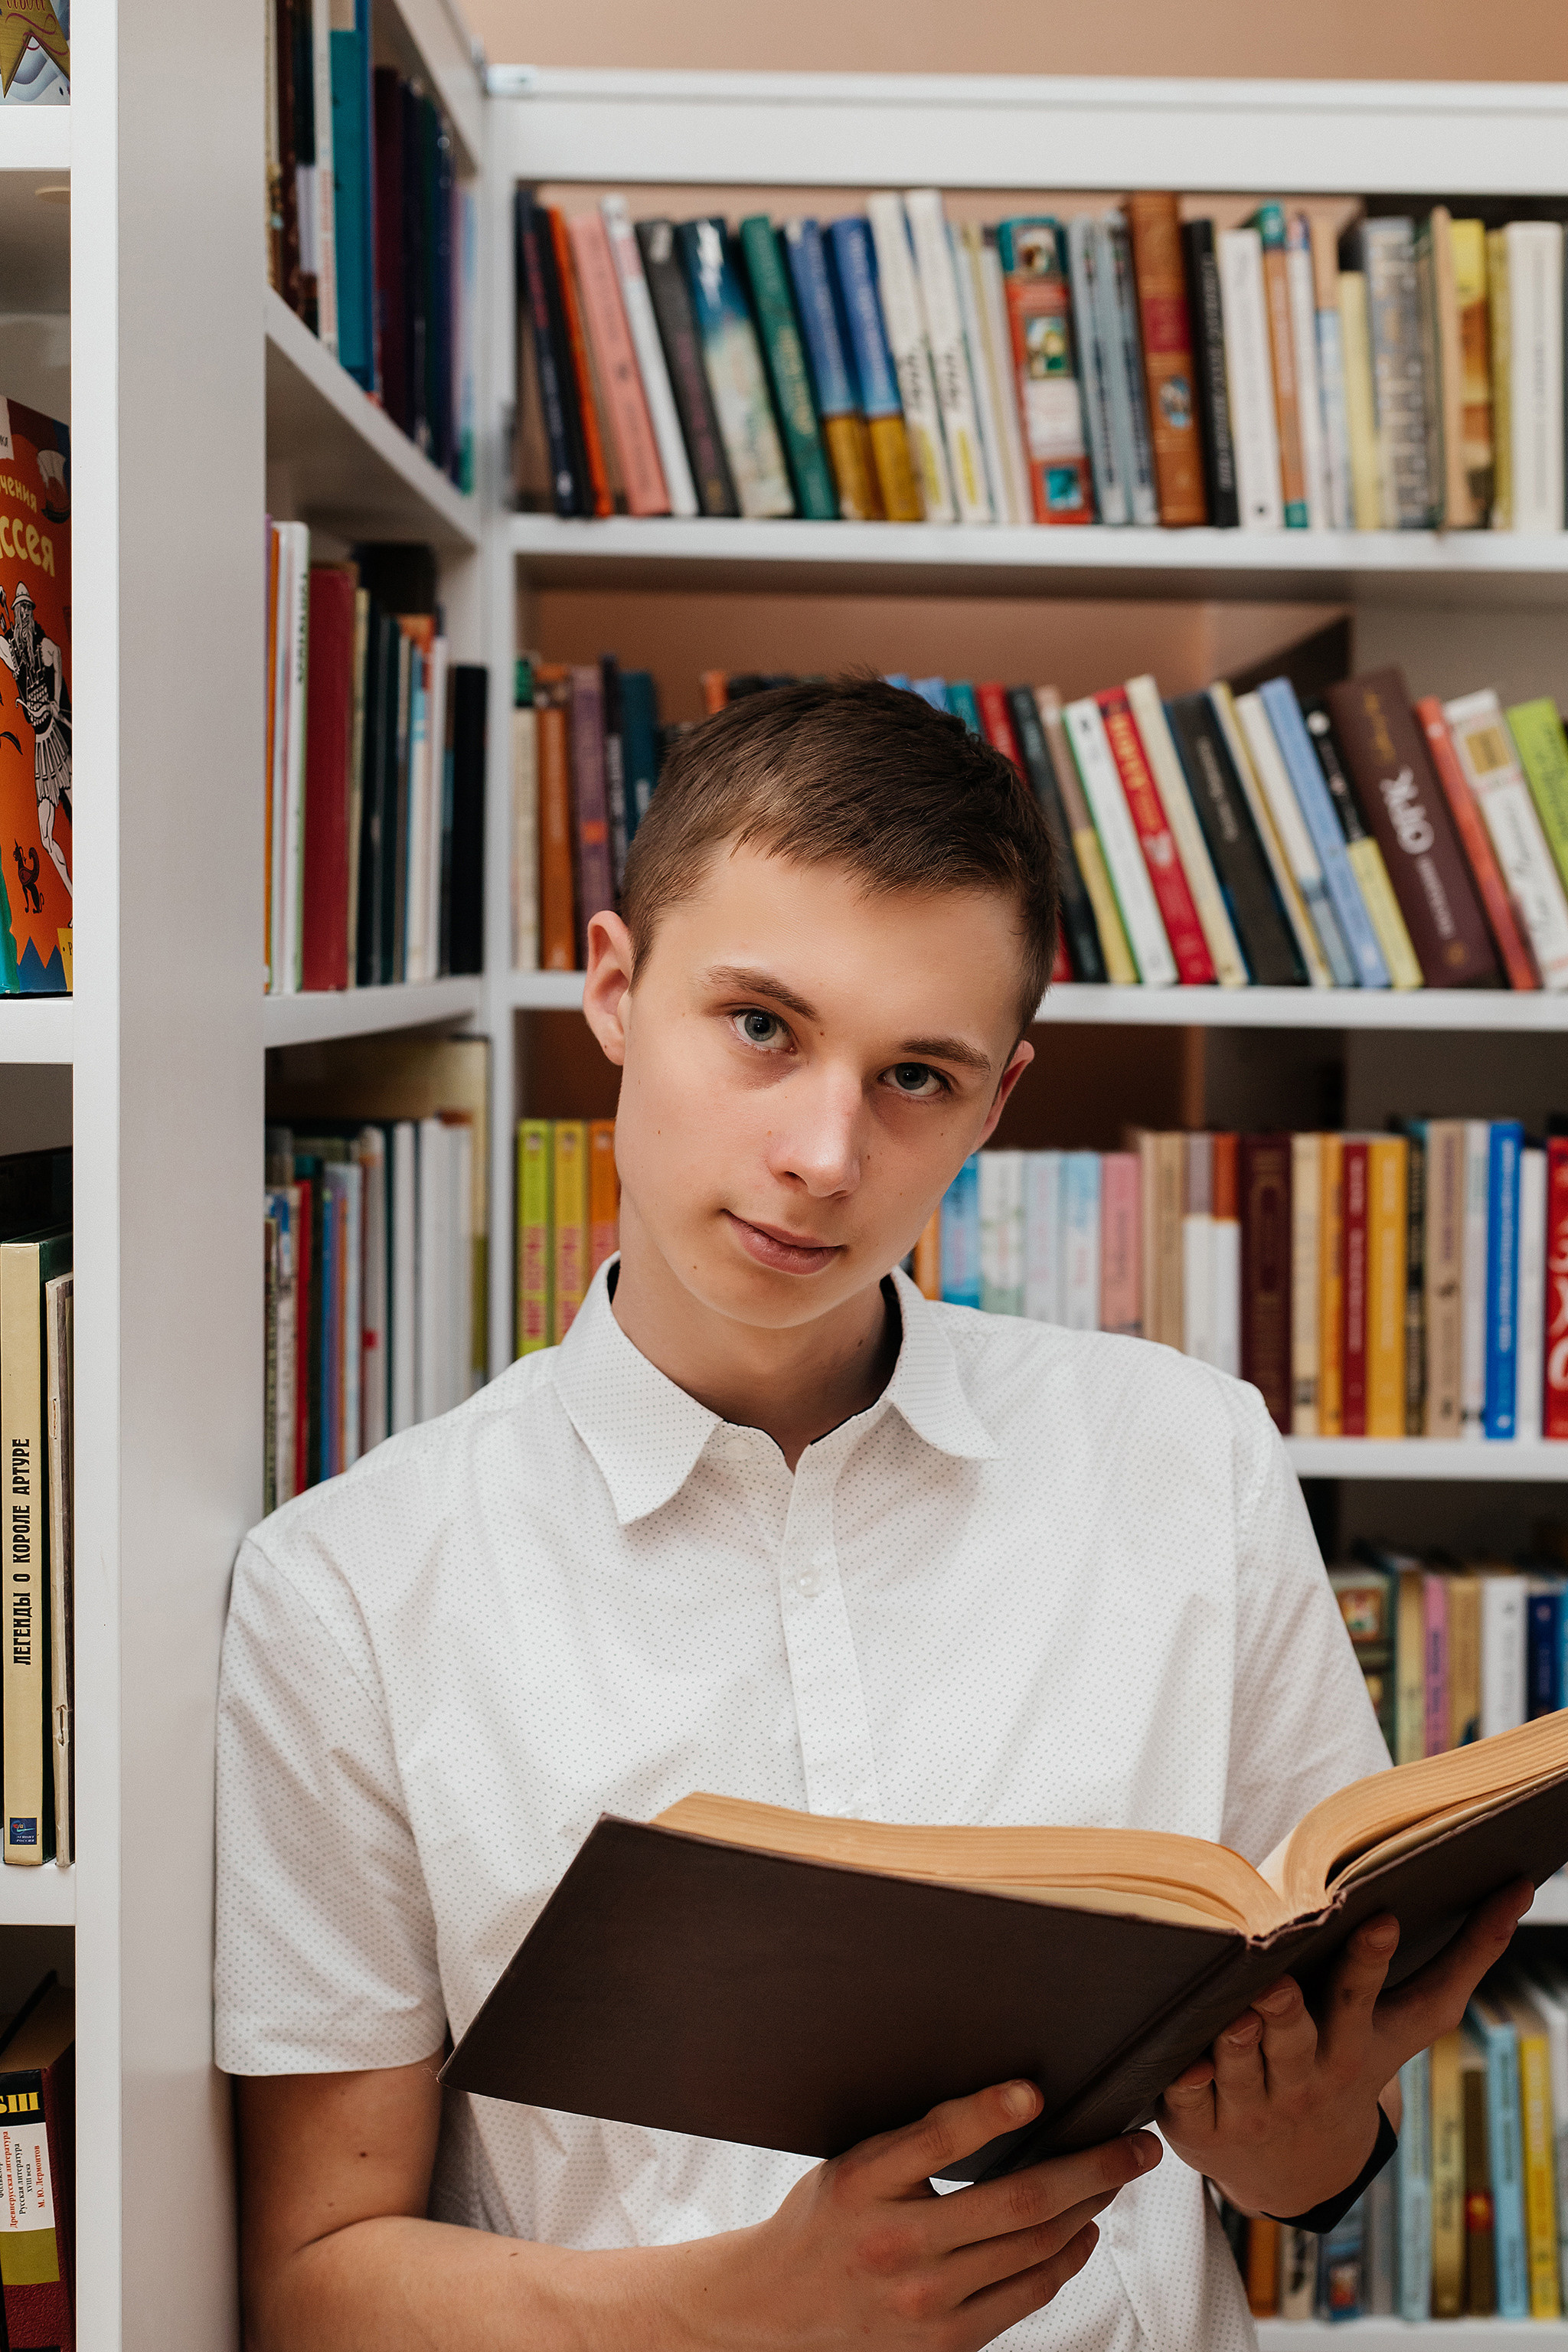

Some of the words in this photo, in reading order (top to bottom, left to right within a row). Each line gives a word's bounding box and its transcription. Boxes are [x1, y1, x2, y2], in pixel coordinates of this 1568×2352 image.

[0, 515, 55, 577] ссея
[11, 1439, 30, 1495] АРТУРЕ
[12, 1505, 31, 1563] КОРОЛЕ
[12, 1573, 31, 1583] О
[12, 1592, 32, 1665] ЛЕГЕНДЫ
[3, 2132, 11, 2172] литература
[15, 2143, 24, 2186] литература
[34, 2145, 44, 2186] Лермонтов
[7, 2174, 18, 2229] Древнерусская
[18, 2187, 28, 2215] Русская
